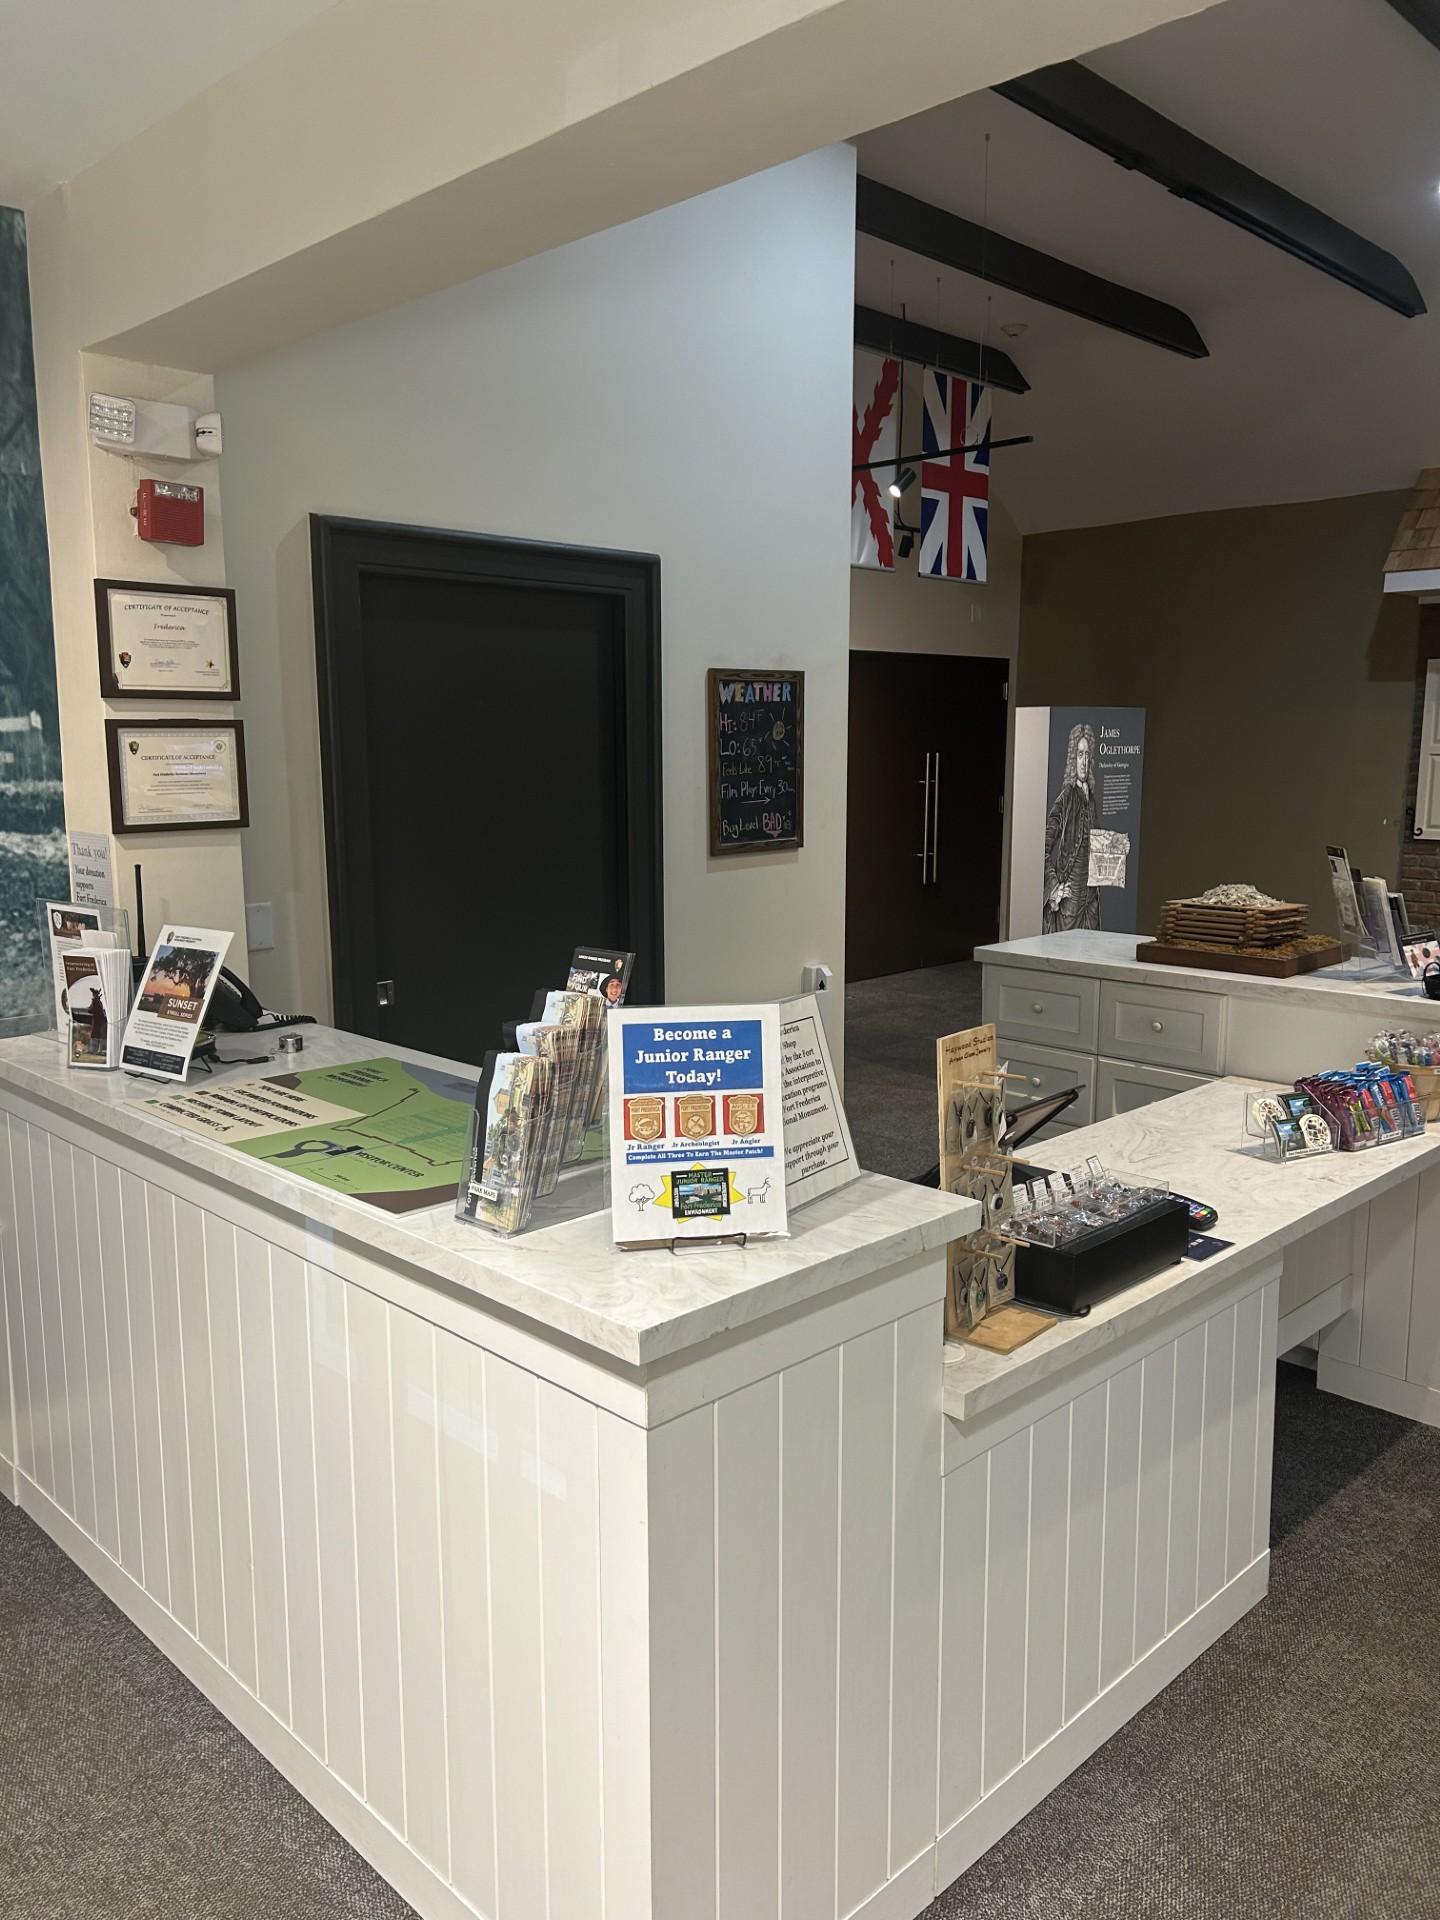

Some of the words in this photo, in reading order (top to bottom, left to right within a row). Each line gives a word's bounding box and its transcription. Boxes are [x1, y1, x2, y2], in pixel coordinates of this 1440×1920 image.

[124, 604, 162, 612] CERTIFICATE
[172, 606, 209, 616] ACCEPTANCE
[719, 682, 792, 704] WEATHER
[722, 820, 738, 838] Bug
[740, 816, 758, 831] Level
[72, 842, 92, 858] Thank
[74, 864, 84, 875] Your
[86, 866, 106, 879] donation
[76, 882, 94, 892] supports
[76, 892, 86, 902] Fort
[168, 998, 198, 1010] SUNSET
[653, 1028, 716, 1042] Become
[722, 1028, 732, 1040] a
[780, 1025, 800, 1035] derica
[634, 1049, 689, 1064] Junior
[692, 1048, 752, 1064] Ranger
[784, 1054, 792, 1064] by
[793, 1052, 802, 1060] the
[802, 1048, 814, 1058] Fort
[785, 1060, 815, 1074] Association
[666, 1069, 722, 1086] Today!
[783, 1079, 792, 1088] the
[792, 1070, 824, 1085] interpretive
[802, 1081, 828, 1096] programs
[795, 1095, 821, 1108] Frederica
[798, 1104, 828, 1120] Monument.
[637, 1142, 665, 1151] Ranger
[680, 1140, 720, 1148] Archeologist
[792, 1136, 820, 1154] appreciate
[821, 1130, 834, 1143] your
[628, 1154, 656, 1162] Complete
[804, 1145, 826, 1160] through
[827, 1141, 840, 1153] your
[356, 1152, 390, 1164] VISITOR
[388, 1164, 424, 1177] CENTER
[801, 1160, 828, 1176] purchase.
